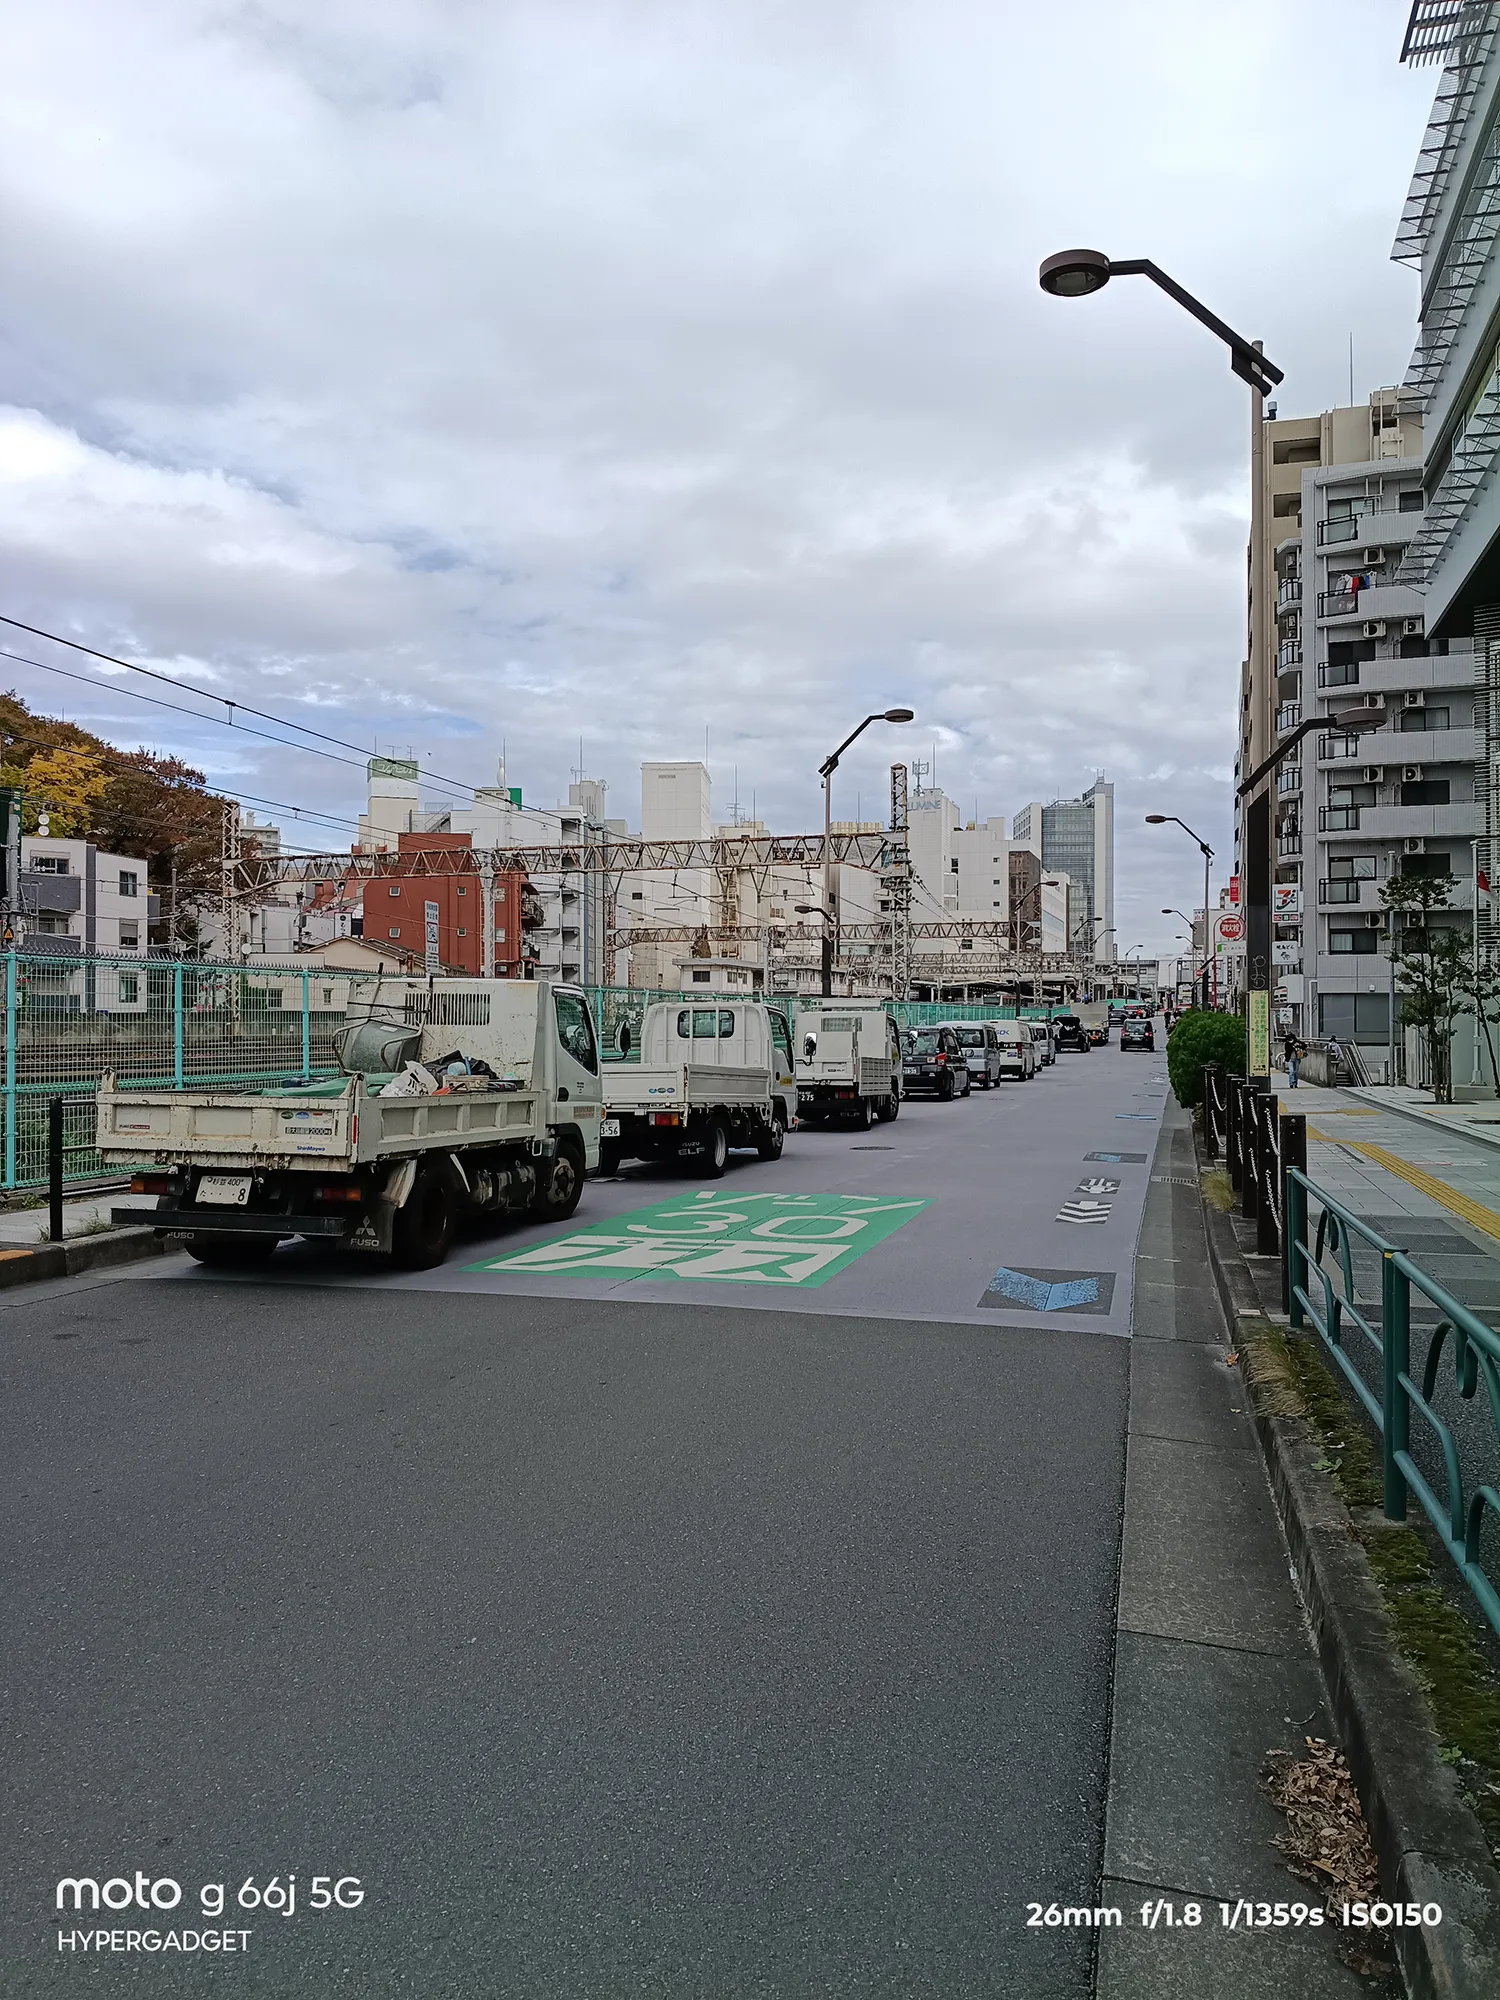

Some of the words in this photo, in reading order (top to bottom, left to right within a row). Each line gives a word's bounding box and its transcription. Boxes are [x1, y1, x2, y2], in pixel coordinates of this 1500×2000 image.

[679, 1147, 706, 1156] ELF
[626, 1211, 869, 1240] 30
[350, 1238, 380, 1247] FUSO
[504, 1238, 820, 1280] プラス
